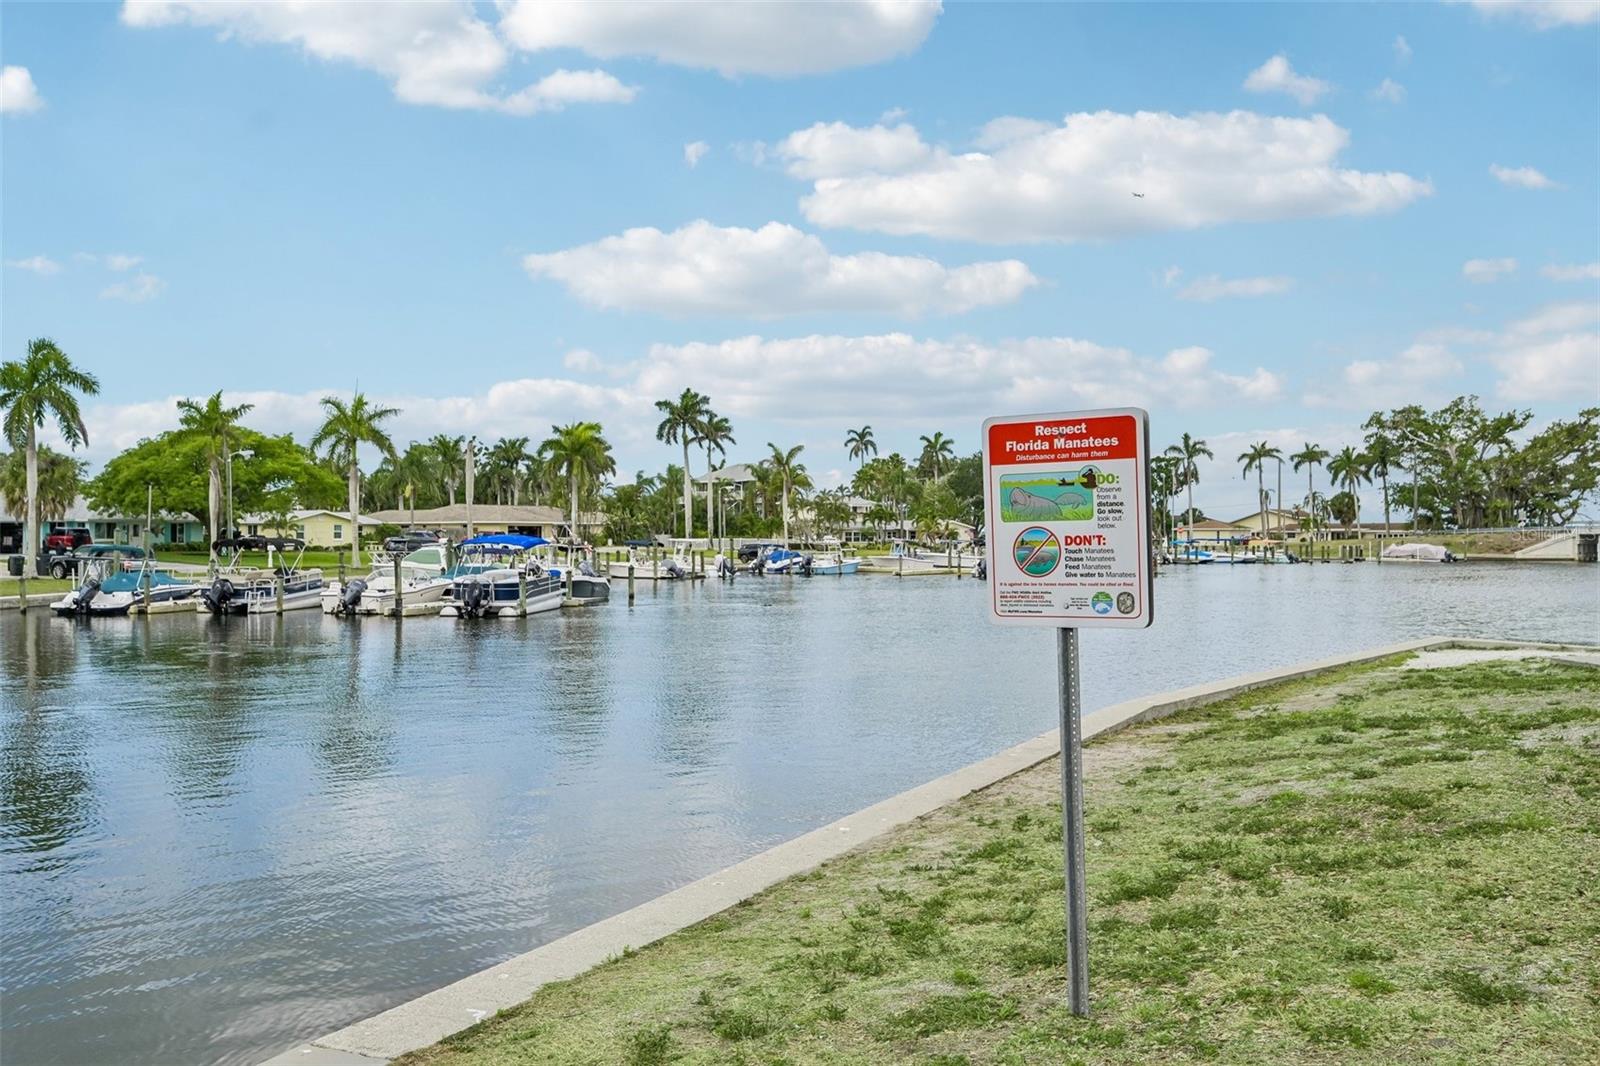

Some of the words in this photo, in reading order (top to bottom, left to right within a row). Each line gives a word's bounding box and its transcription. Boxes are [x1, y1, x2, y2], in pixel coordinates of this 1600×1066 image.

[1035, 422, 1087, 436] Respect
[1005, 440, 1049, 452] Florida
[1053, 436, 1119, 450] Manatees
[1015, 453, 1055, 461] Disturbance
[1071, 451, 1089, 459] harm
[1096, 473, 1119, 484] DO:
[1064, 535, 1106, 546] DON'T:
